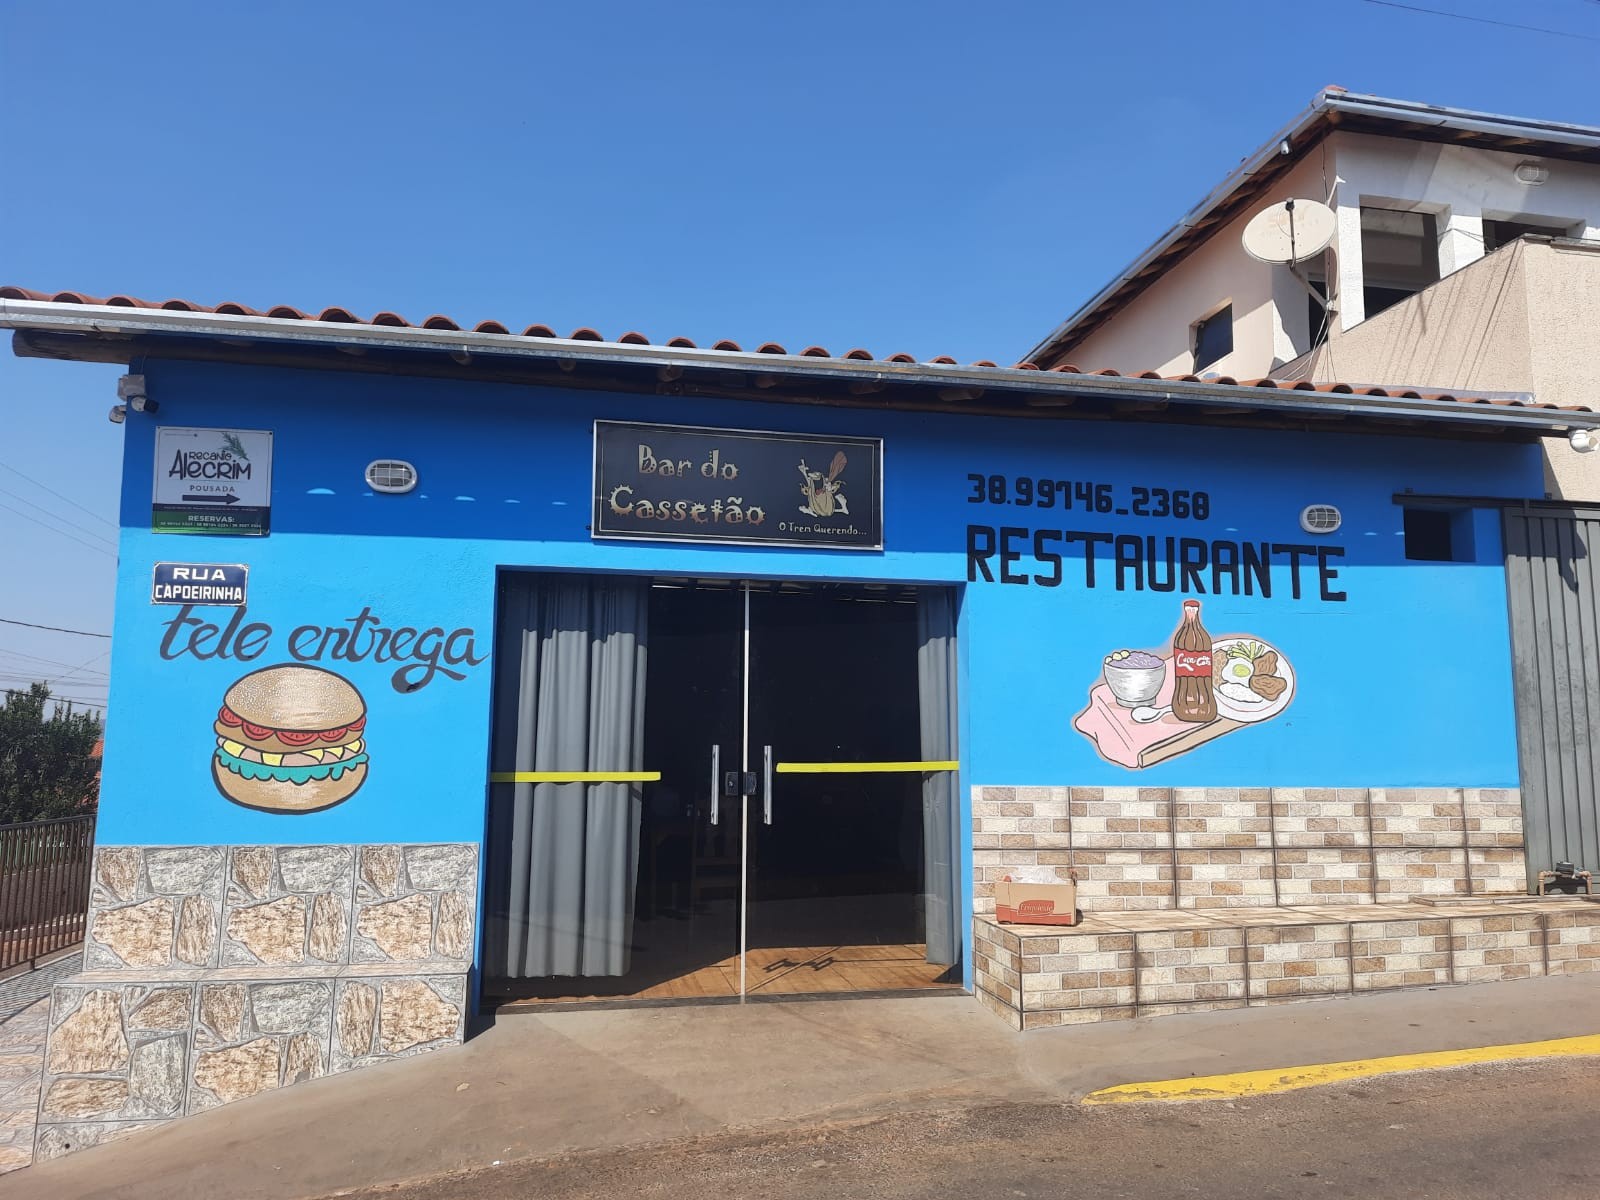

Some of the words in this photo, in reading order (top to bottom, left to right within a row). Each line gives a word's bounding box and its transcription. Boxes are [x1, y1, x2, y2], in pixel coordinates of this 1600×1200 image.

[638, 444, 692, 478] Bar
[701, 450, 740, 480] do
[190, 484, 236, 493] POUSADA
[608, 484, 766, 526] Cassetão
[188, 515, 235, 523] RESERVAS:
[778, 521, 787, 531] O
[788, 521, 812, 533] Tren
[966, 524, 1347, 602] RESTAURANTE
[173, 567, 227, 581] RUA
[155, 584, 243, 601] CAPOEIRINHA
[160, 605, 273, 661] tele
[288, 607, 489, 693] entrega
